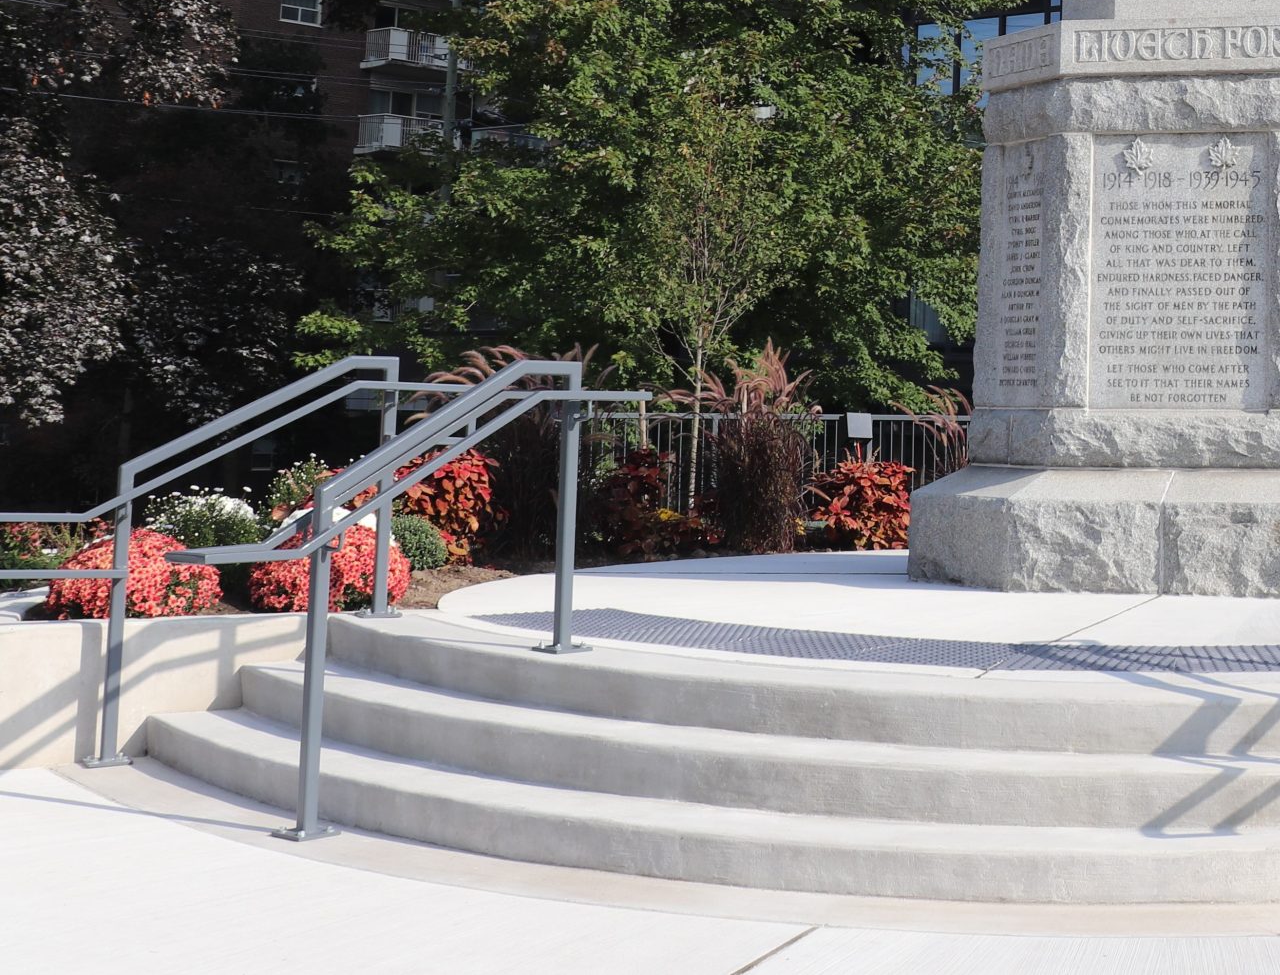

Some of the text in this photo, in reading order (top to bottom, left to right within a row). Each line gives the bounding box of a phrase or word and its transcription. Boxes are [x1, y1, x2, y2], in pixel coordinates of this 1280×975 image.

[1110, 201, 1251, 210] THOSE WHOM THIS MEMORIAL
[1100, 215, 1180, 225] COMMEMORATES
[1183, 215, 1209, 225] WERE
[1104, 230, 1139, 239] AMONG
[1142, 230, 1172, 239] THOSE
[1200, 230, 1212, 239] AT
[1214, 230, 1231, 239] THE
[1233, 230, 1257, 239] CALL
[1109, 244, 1121, 253] OF
[1125, 244, 1149, 253] KING
[1152, 244, 1172, 253] AND
[1227, 244, 1251, 253] LEFT
[1105, 258, 1123, 267] ALL
[1126, 258, 1151, 267] THAT
[1155, 258, 1177, 267] WAS
[1180, 258, 1207, 267] DEAR
[1210, 258, 1222, 267] TO
[1097, 273, 1140, 282] ENDURED
[1193, 273, 1222, 282] FACED
[1107, 287, 1251, 296] AND FINALLY PASSED OUT OF
[1103, 301, 1257, 311] THE SIGHT OF MEN BY THE PATH
[1106, 315, 1117, 325] OF
[1120, 315, 1149, 325] DUTY
[1152, 315, 1173, 325] AND
[1098, 330, 1260, 340] GIVING UP THEIR OWN LIVES THAT
[1098, 345, 1135, 355] OTHERS
[1139, 345, 1171, 355] MIGHT
[1174, 345, 1194, 355] LIVE
[1197, 345, 1207, 355] IN
[1106, 364, 1250, 374] LET THOSE WHO COME AFTER
[1107, 379, 1250, 388] SEE TO IT THAT THEIR NAMES
[1130, 393, 1227, 403] BE NOT FORGOTTEN
